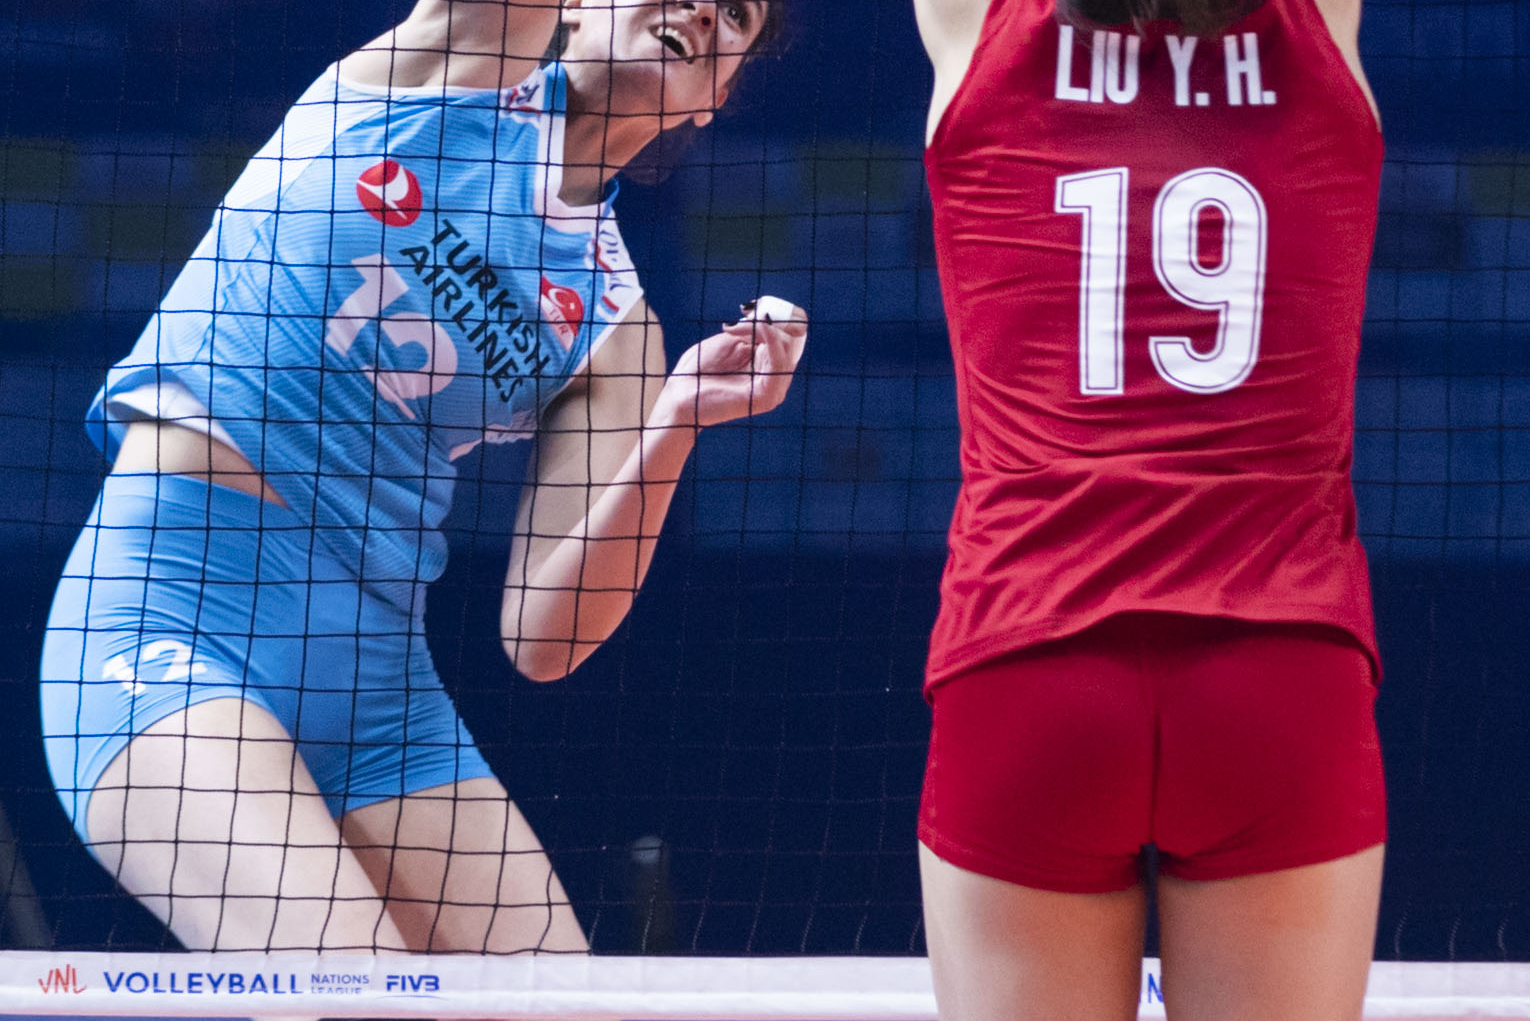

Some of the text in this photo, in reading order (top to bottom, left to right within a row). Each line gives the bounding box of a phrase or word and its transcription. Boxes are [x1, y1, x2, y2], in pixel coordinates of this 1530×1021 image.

[1055, 24, 1277, 106] LIU Y. H.
[430, 219, 550, 375] TURKISH
[1054, 167, 1268, 395] 19
[399, 245, 523, 403] AIRLINES
[101, 639, 208, 696] 12
[103, 971, 305, 995] VOLLEYBALL
[310, 973, 370, 985] NATIONS
[386, 974, 440, 992] FIVB
